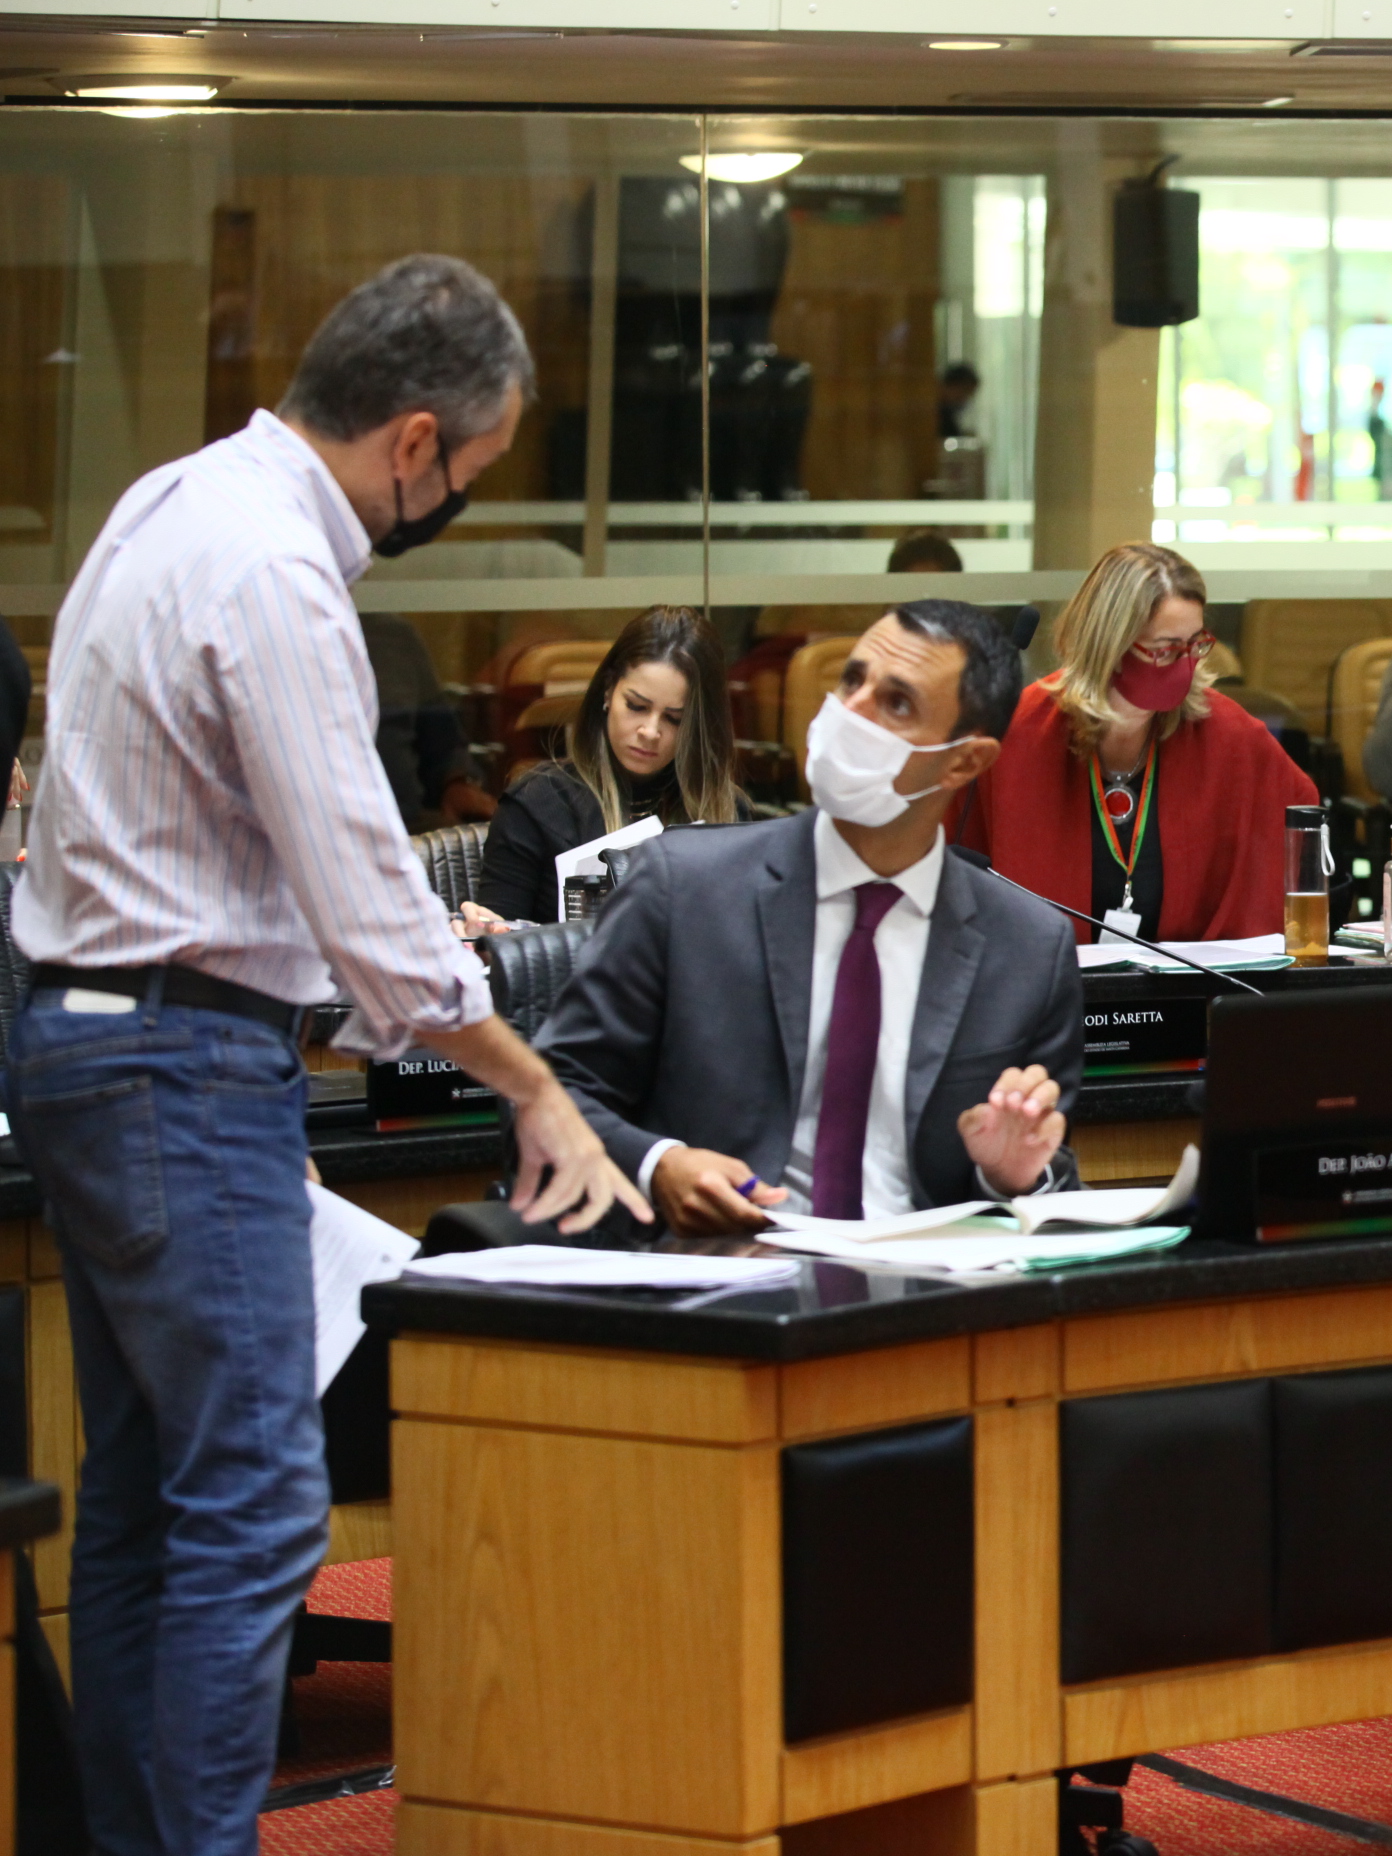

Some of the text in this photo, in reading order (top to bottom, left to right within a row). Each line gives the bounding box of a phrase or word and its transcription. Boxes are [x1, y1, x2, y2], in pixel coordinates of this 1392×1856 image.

[1082, 1011, 1164, 1026] ODI SARETTA
[398, 1061, 425, 1076] DEP.
[1349, 1152, 1387, 1175] JOÃO
